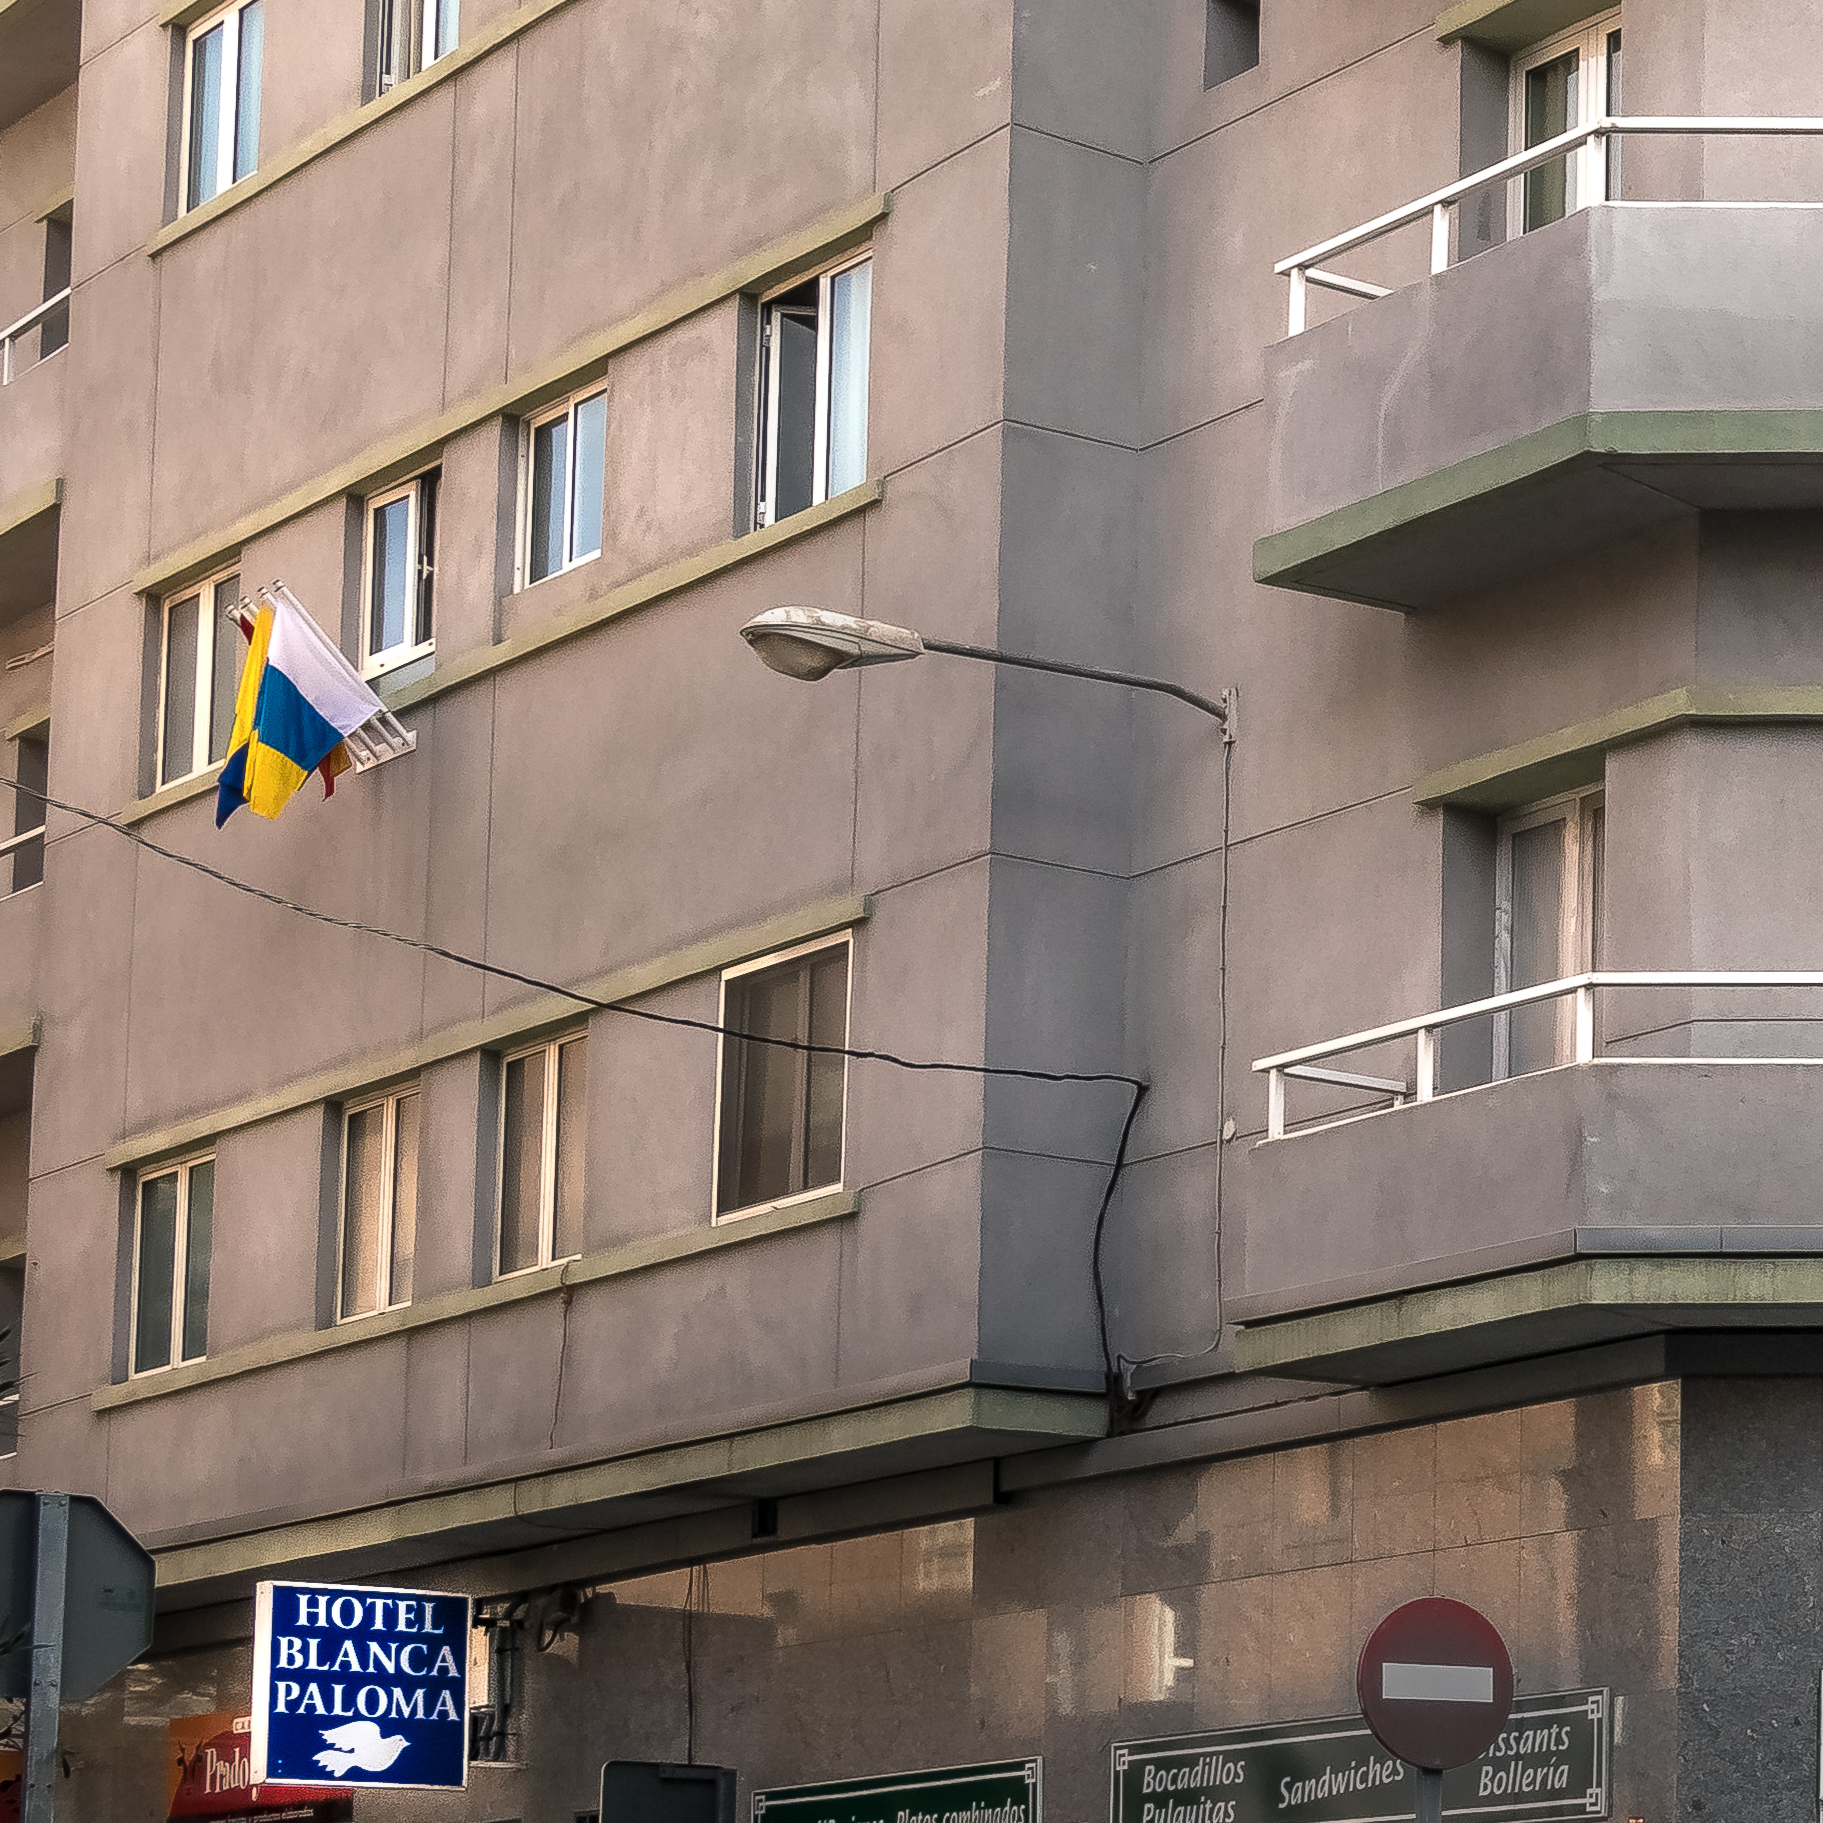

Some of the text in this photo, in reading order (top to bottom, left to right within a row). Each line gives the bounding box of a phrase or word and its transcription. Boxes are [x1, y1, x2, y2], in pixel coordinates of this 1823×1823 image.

[294, 1593, 445, 1634] HOTEL
[275, 1635, 461, 1678] BLANCA
[272, 1680, 461, 1722] PALOMA
[1142, 1755, 1246, 1794] Bocadillos
[1278, 1756, 1405, 1809] Sandwiches
[1478, 1756, 1569, 1797] Bollería
